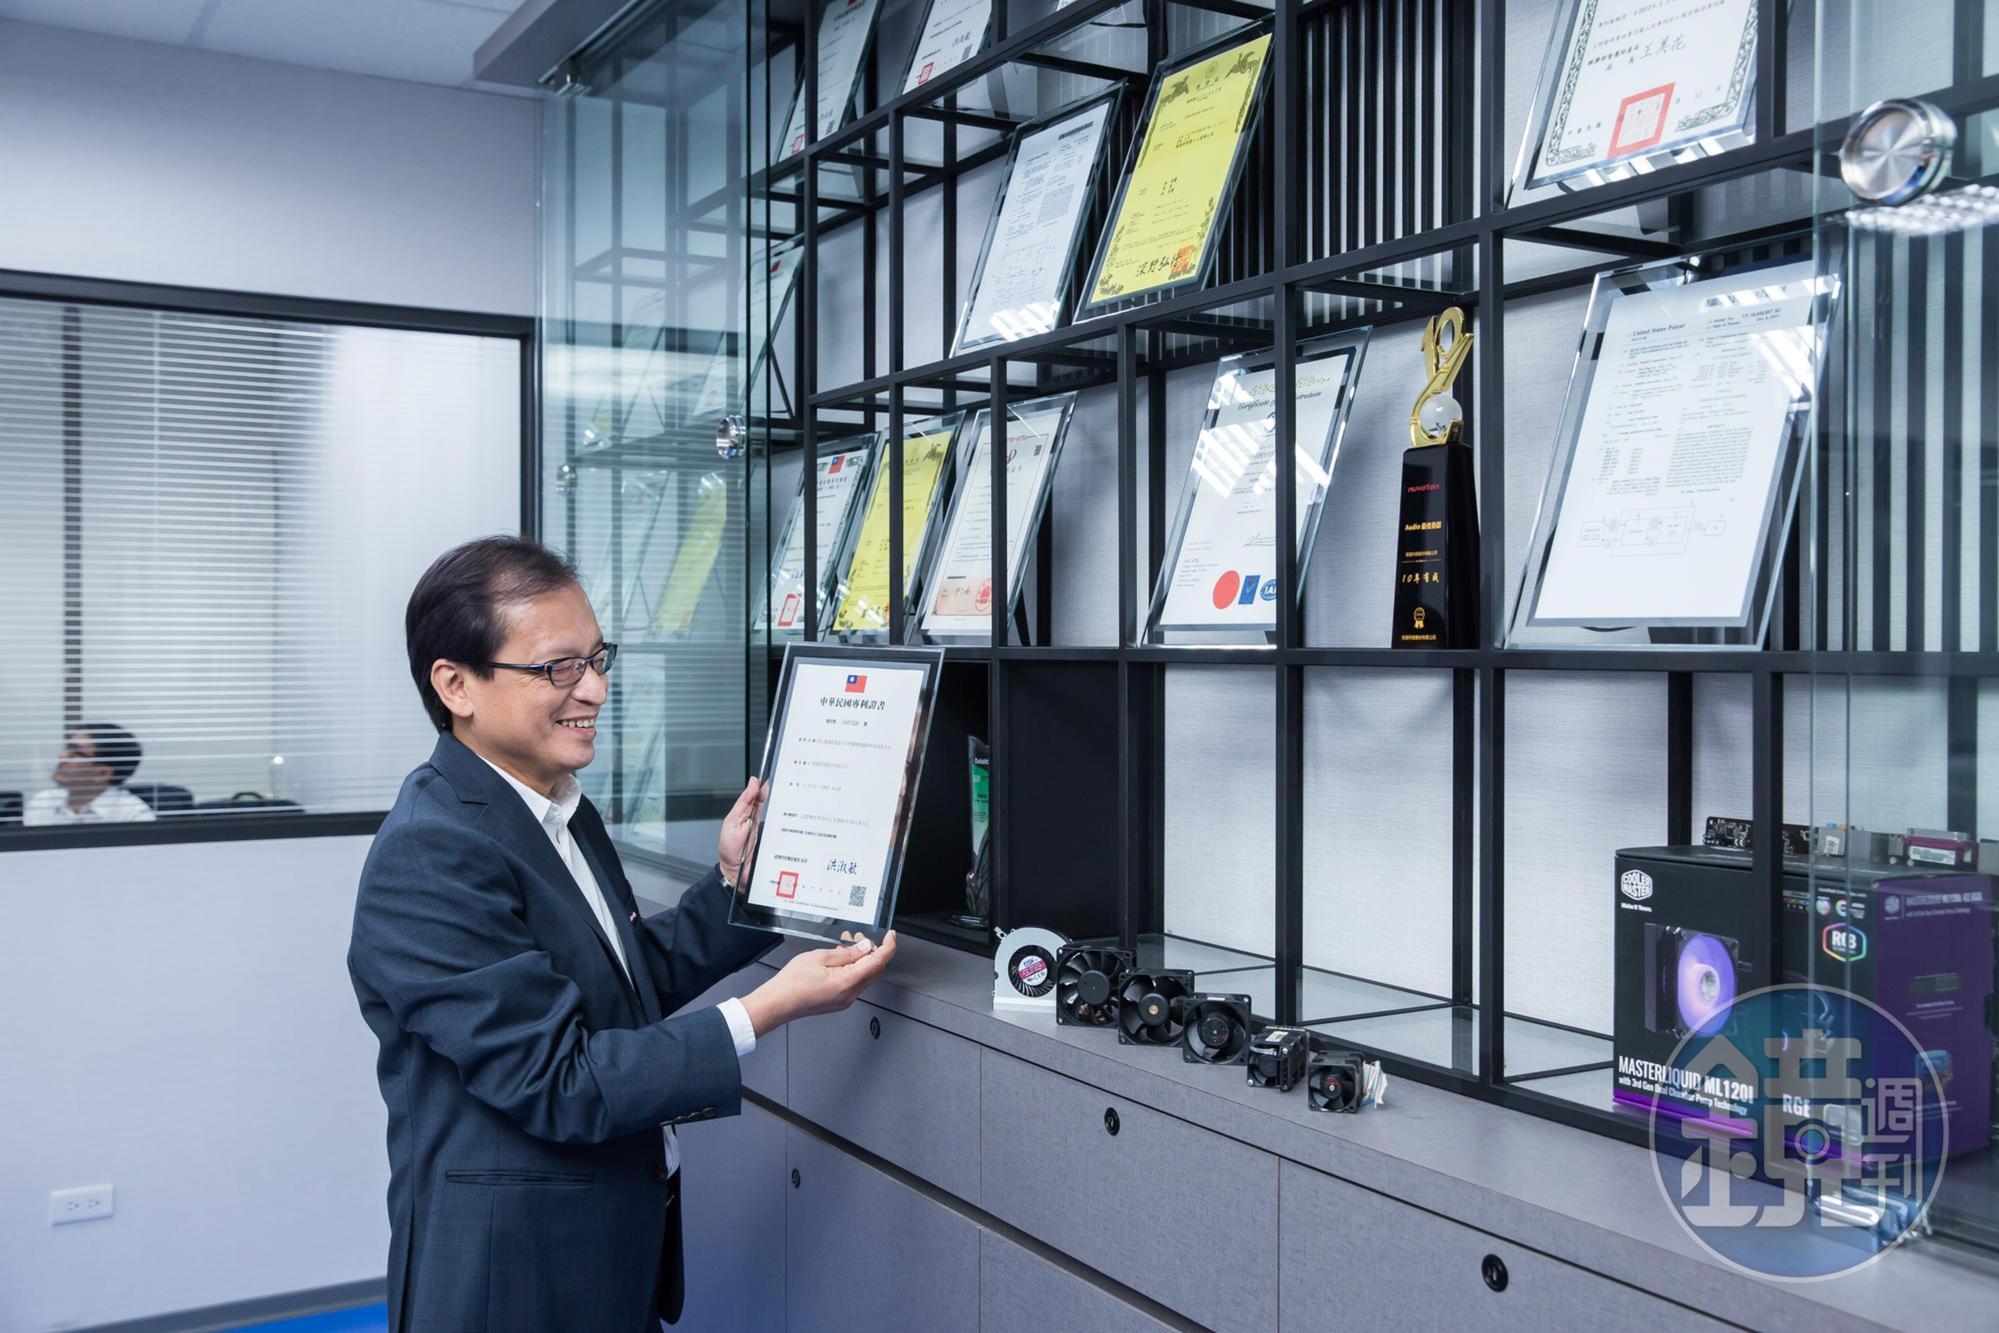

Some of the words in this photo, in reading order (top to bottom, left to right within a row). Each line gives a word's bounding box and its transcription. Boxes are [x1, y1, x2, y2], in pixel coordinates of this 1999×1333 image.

[1622, 872, 1650, 886] COOLER
[1623, 883, 1650, 898] MASTER
[1618, 1055, 1701, 1091] MASTERLIQUID
[1618, 1077, 1631, 1086] with
[1632, 1079, 1642, 1089] 3rd
[1642, 1082, 1654, 1092] Gen
[1713, 1097, 1748, 1116] Technology
